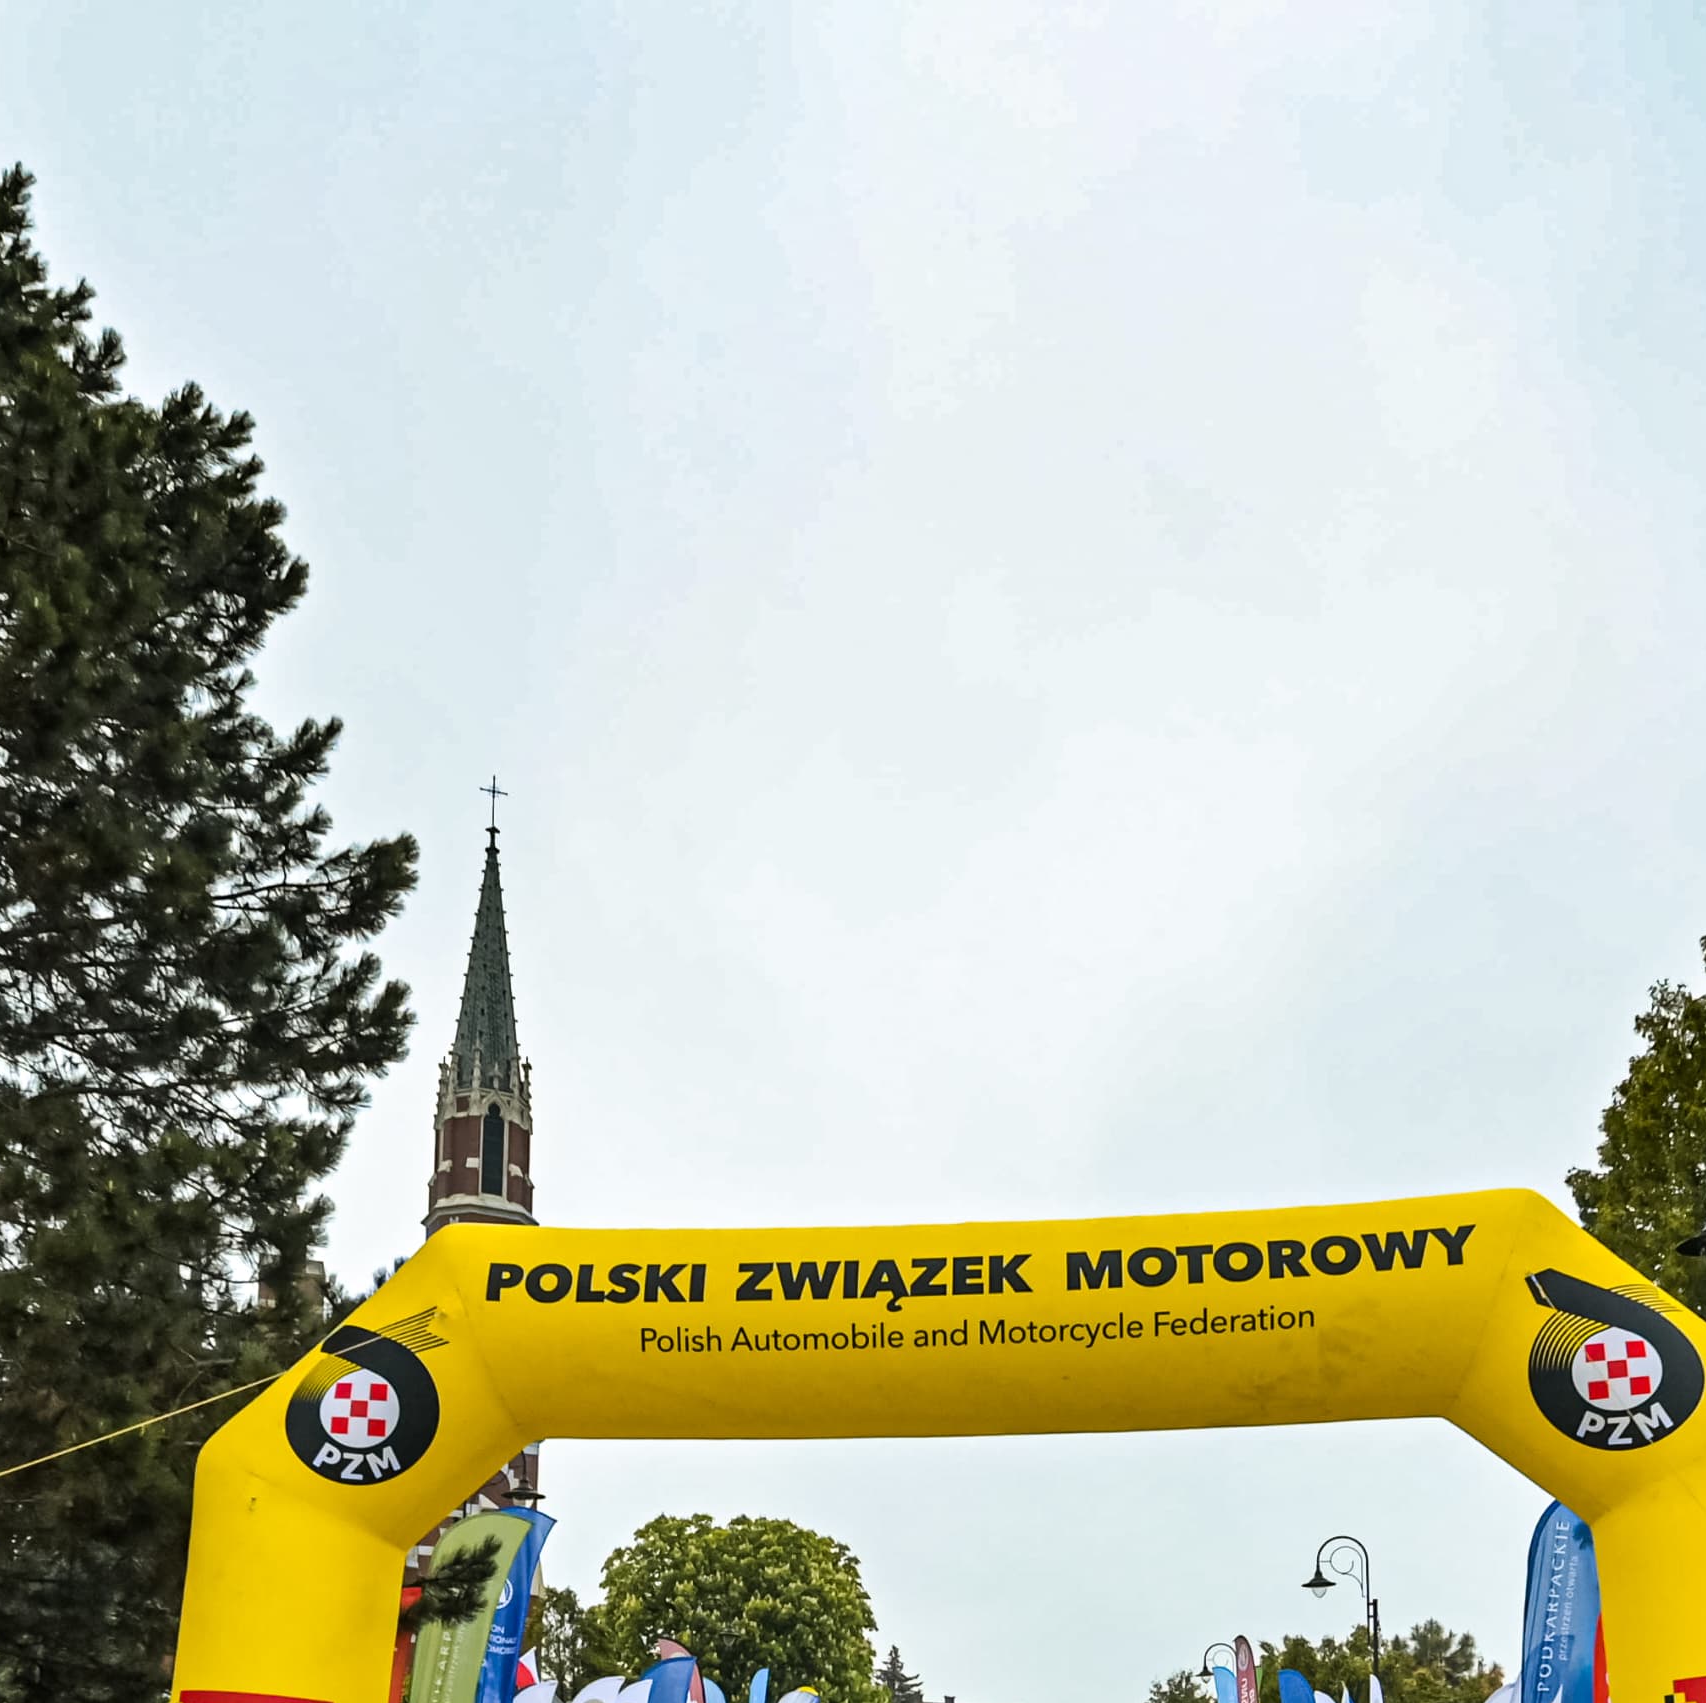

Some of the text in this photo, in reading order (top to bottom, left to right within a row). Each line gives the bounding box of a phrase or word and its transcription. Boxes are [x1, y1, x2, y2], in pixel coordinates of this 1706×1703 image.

[486, 1224, 1476, 1312] POLSKI ZWIĄZEK MOTOROWY
[640, 1304, 1316, 1354] Polish Automobile and Motorcycle Federation
[1576, 1402, 1675, 1446] PZM
[312, 1442, 402, 1480] PZM
[1537, 1521, 1570, 1694] PODKARPACKIE
